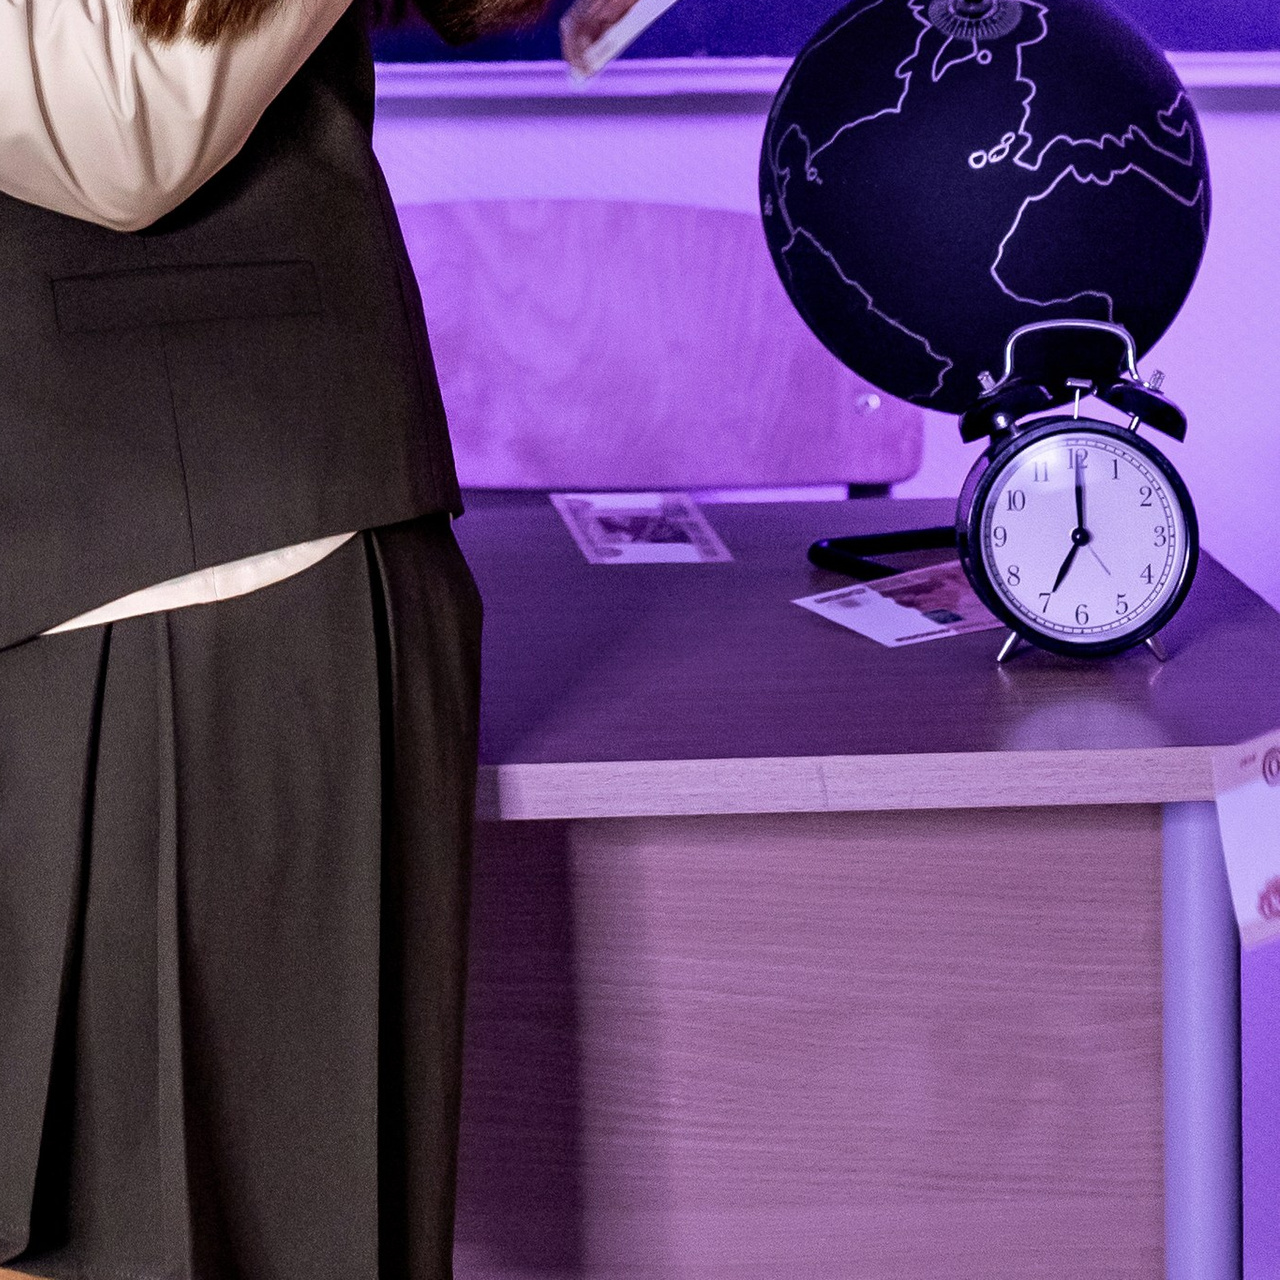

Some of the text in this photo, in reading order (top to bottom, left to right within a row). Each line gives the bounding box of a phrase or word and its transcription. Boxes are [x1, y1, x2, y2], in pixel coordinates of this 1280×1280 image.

[1032, 462, 1050, 483] 11
[1111, 459, 1120, 481] 1
[1006, 489, 1027, 512] 10
[1139, 485, 1153, 508] 2
[993, 526, 1008, 548] 9
[1153, 525, 1167, 548] 3
[1006, 565, 1021, 587] 8
[1139, 563, 1155, 585] 4
[1038, 592, 1052, 614] 7
[1115, 593, 1129, 616] 5
[1075, 603, 1090, 626] 6
